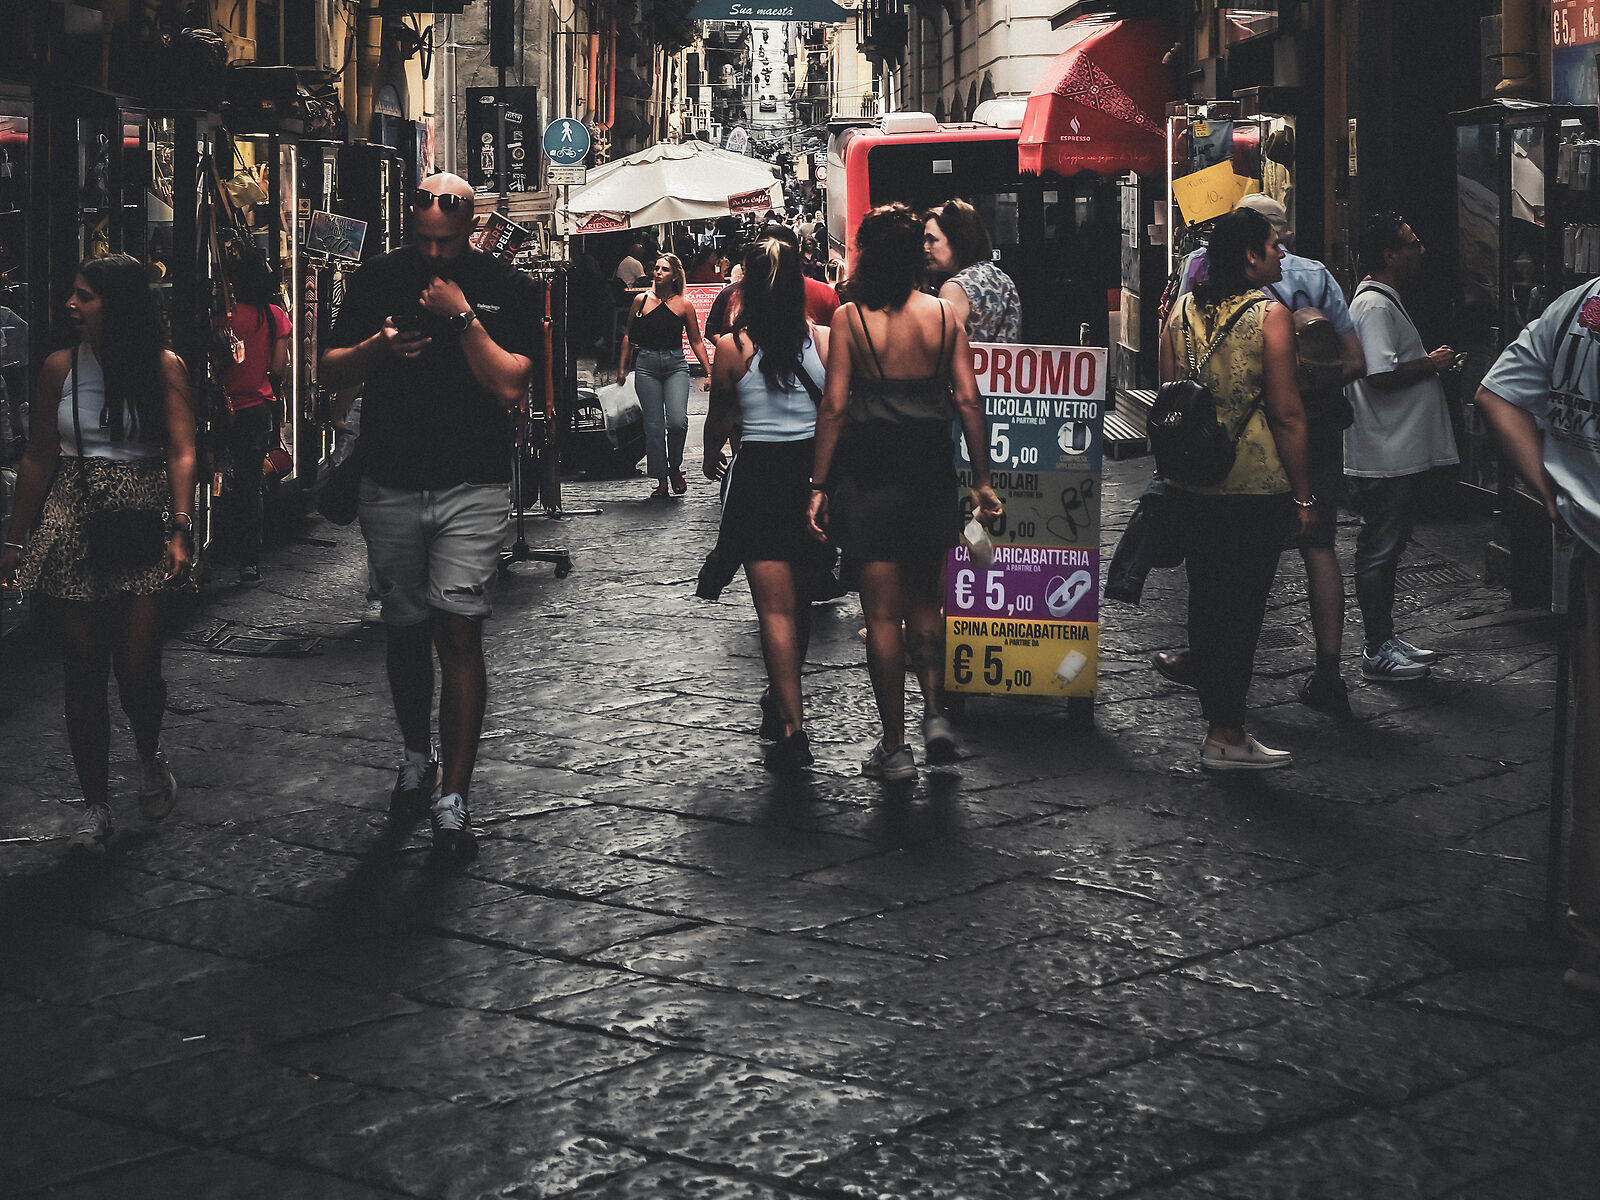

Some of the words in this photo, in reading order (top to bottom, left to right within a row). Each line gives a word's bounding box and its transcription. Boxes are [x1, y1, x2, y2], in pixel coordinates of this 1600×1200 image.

[729, 3, 753, 16] Sua
[756, 6, 794, 16] maestà
[1553, 9, 1560, 46] €
[496, 224, 515, 250] PELLE
[969, 348, 1097, 397] PROMO
[985, 398, 1033, 417] LICOLA
[1036, 399, 1050, 417] IN
[1054, 401, 1098, 419] VETRO
[1016, 417, 1038, 425] PARTIRE
[989, 422, 1038, 469] 5,00
[959, 471, 1039, 490] AUCOLARI
[993, 547, 1090, 567] ARICABATTERIA
[1011, 564, 1033, 572] PARTIRE
[954, 568, 976, 610] €
[985, 570, 1034, 616] 5,00
[953, 620, 988, 637] SPINA
[991, 622, 1090, 641] CARICABATTERIA
[1032, 639, 1040, 647] DA
[953, 643, 973, 685] €
[983, 645, 1032, 691] 5,00
